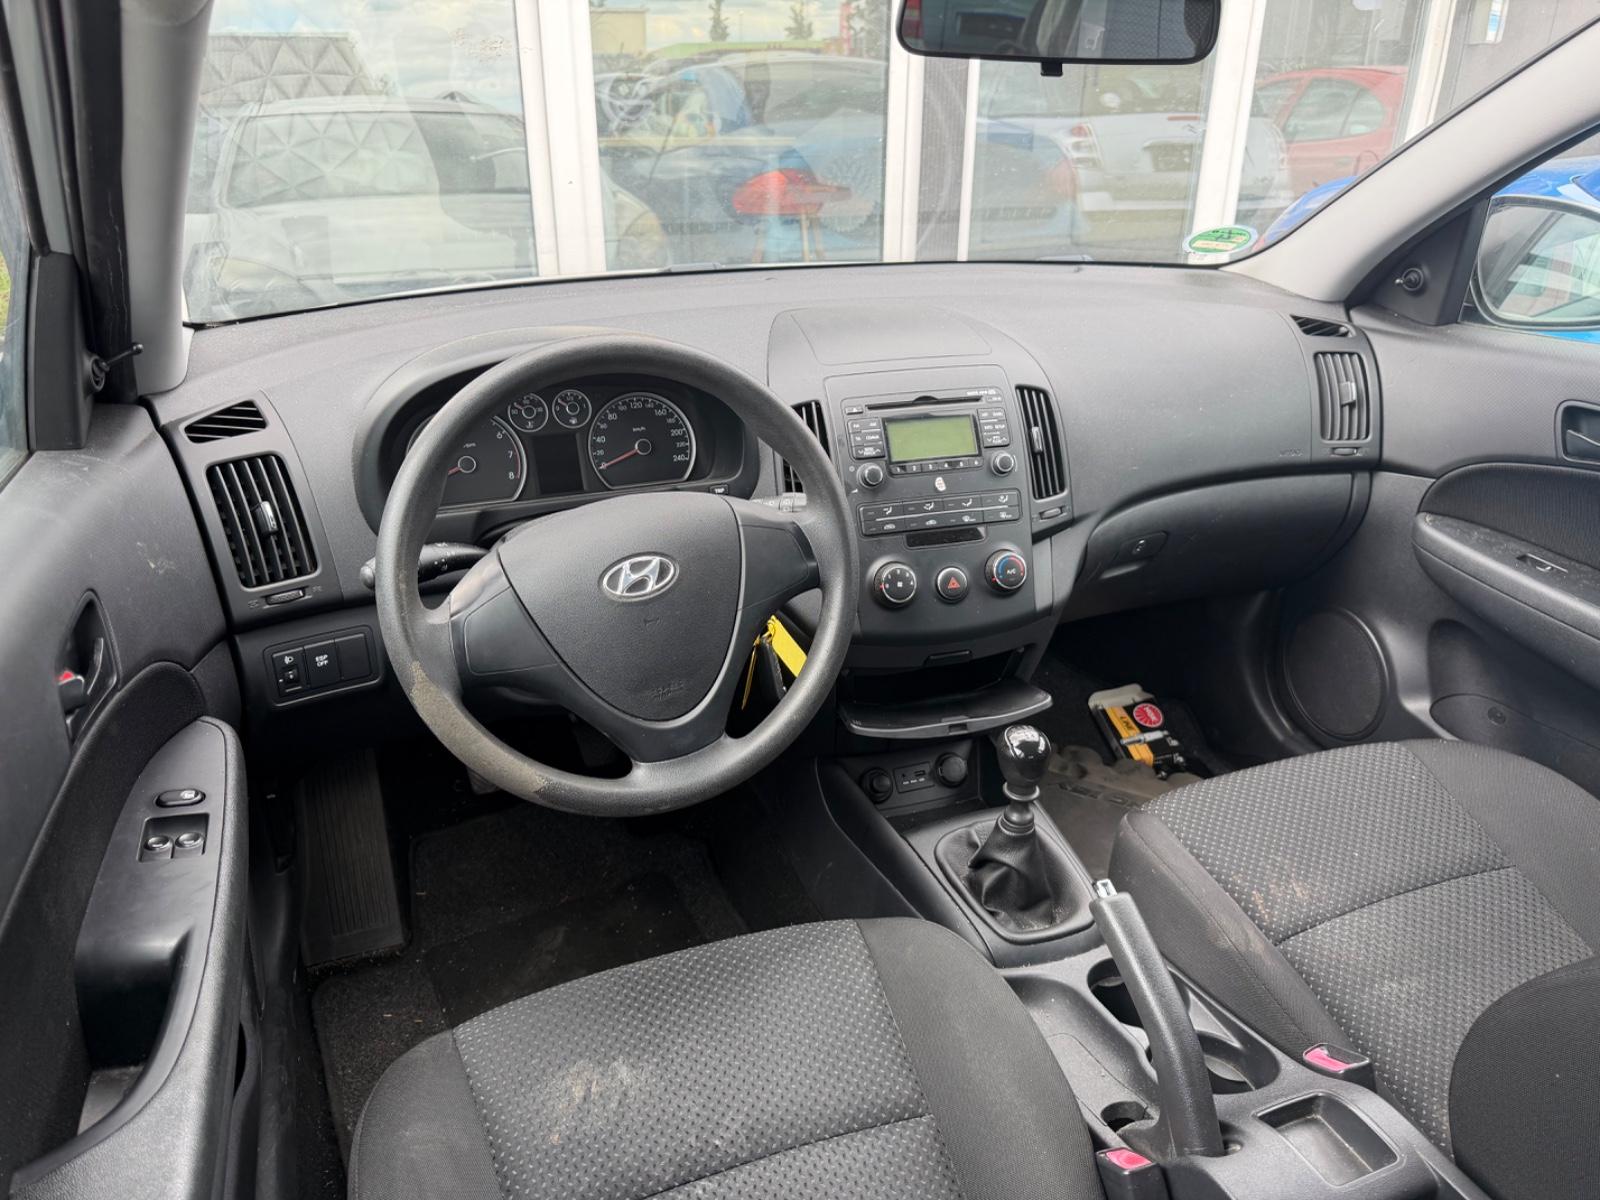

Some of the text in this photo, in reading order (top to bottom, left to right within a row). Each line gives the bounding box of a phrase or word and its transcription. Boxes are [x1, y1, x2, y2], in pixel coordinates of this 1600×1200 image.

[607, 412, 618, 421] 80
[654, 408, 667, 416] 160
[670, 428, 683, 437] 200
[507, 450, 513, 459] 7
[672, 454, 686, 462] 240
[508, 471, 515, 480] 8
